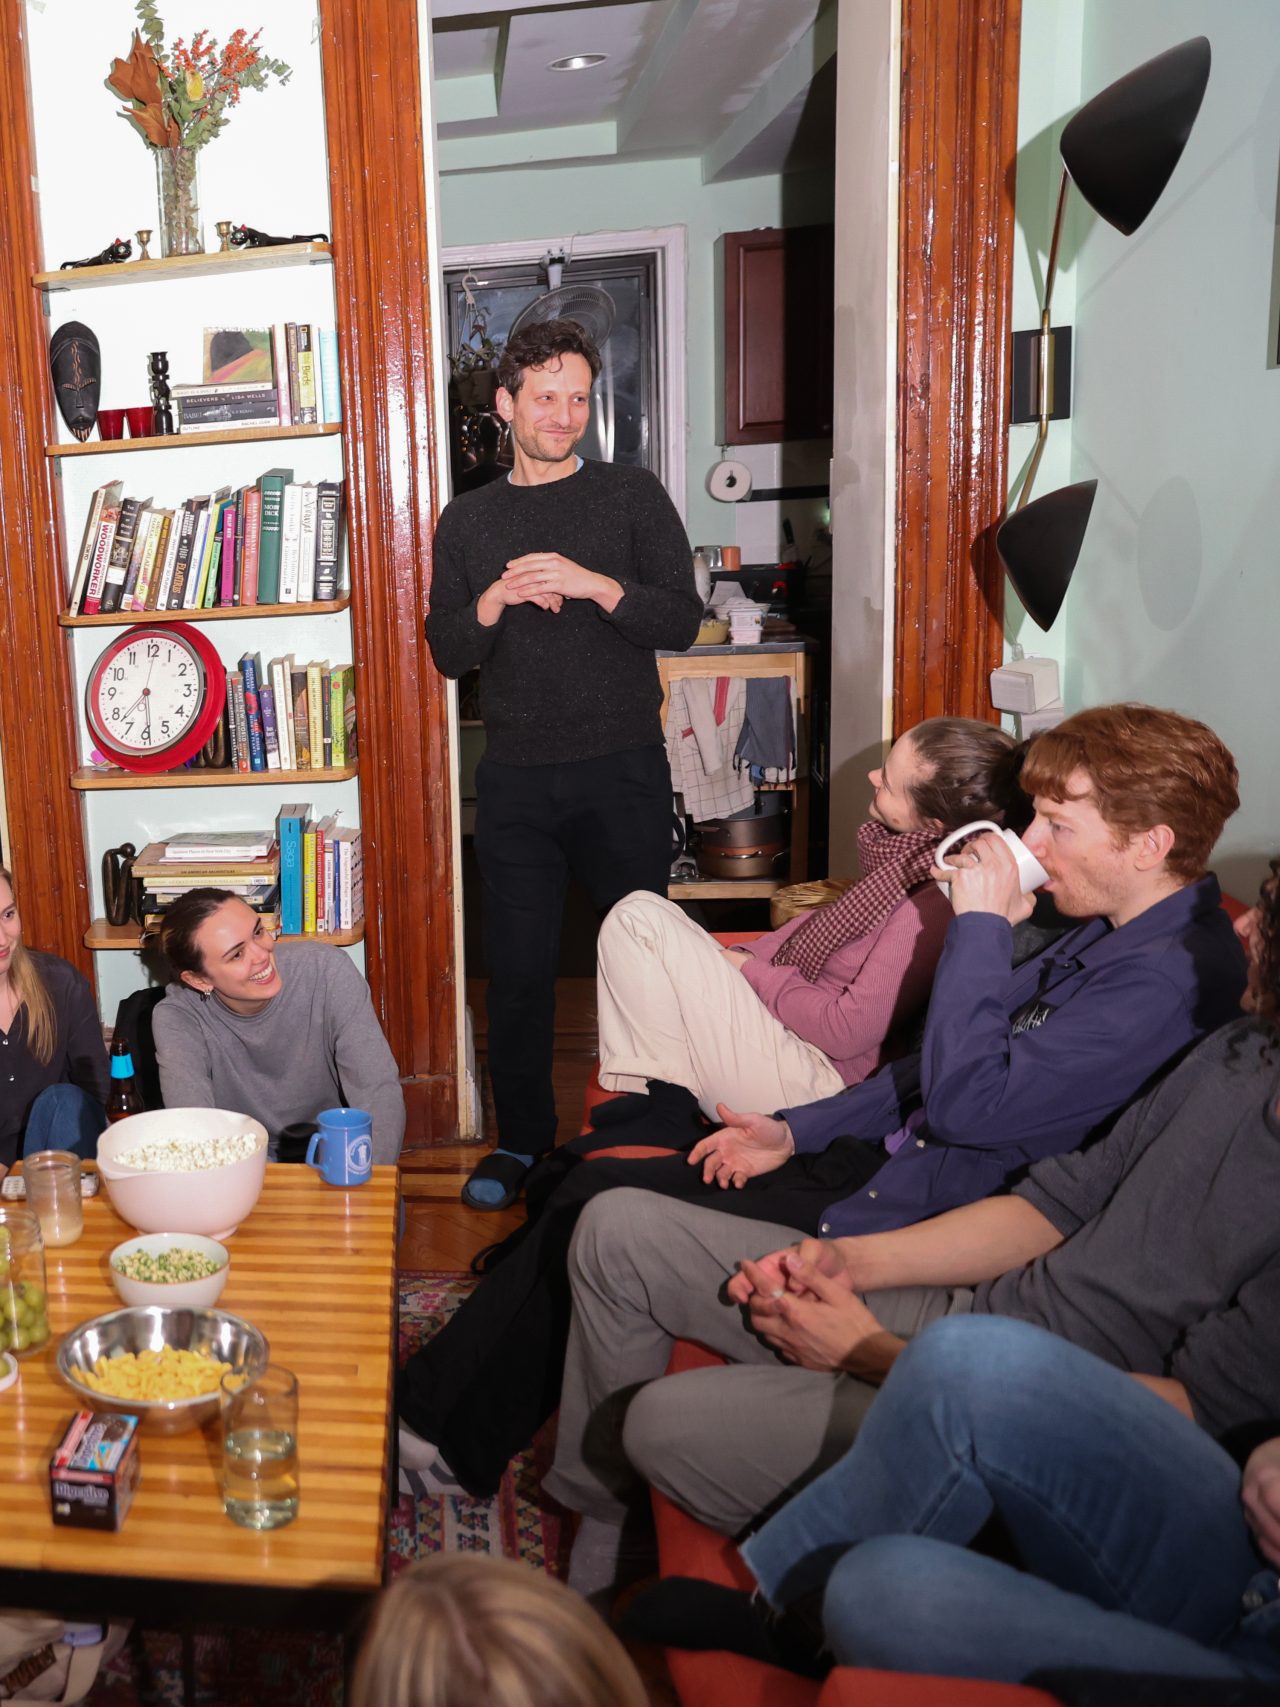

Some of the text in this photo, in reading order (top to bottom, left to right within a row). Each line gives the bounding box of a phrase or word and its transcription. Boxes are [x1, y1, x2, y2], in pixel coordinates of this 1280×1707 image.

[88, 523, 109, 596] WOODWORKER
[171, 561, 186, 594] ELANTRIS
[147, 644, 159, 658] 12
[129, 652, 136, 665] 11
[114, 668, 124, 681] 10
[178, 663, 186, 676] 2
[108, 687, 117, 700] 9
[183, 684, 192, 697] 3
[112, 708, 120, 720] 8
[175, 705, 184, 717] 4
[125, 722, 134, 735] 7
[141, 725, 150, 740] 6
[161, 721, 170, 734] 5
[284, 840, 295, 866] Saga
